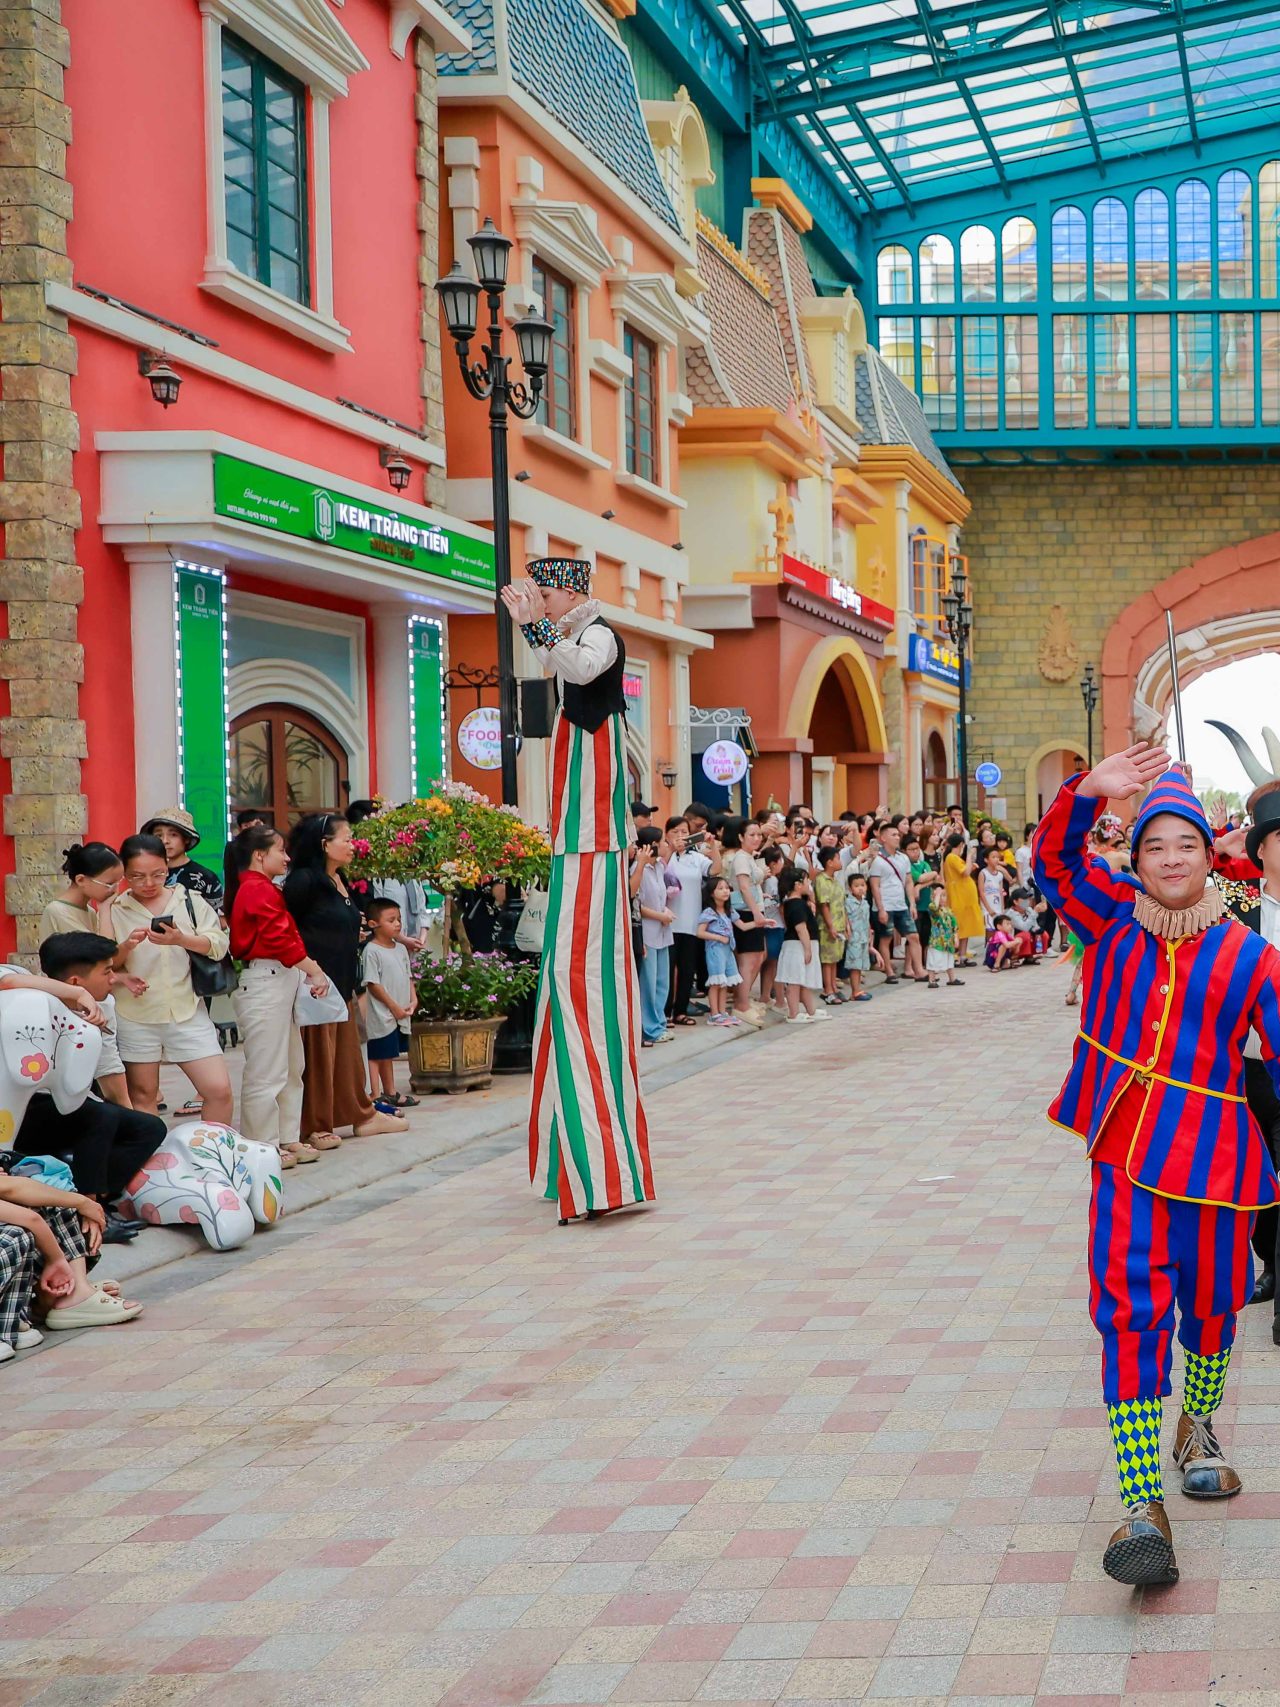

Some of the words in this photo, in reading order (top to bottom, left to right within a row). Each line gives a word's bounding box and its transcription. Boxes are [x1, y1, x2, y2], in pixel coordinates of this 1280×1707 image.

[339, 502, 370, 531] KEM
[373, 512, 419, 545] TRÀNG
[421, 525, 449, 555] TIỀN
